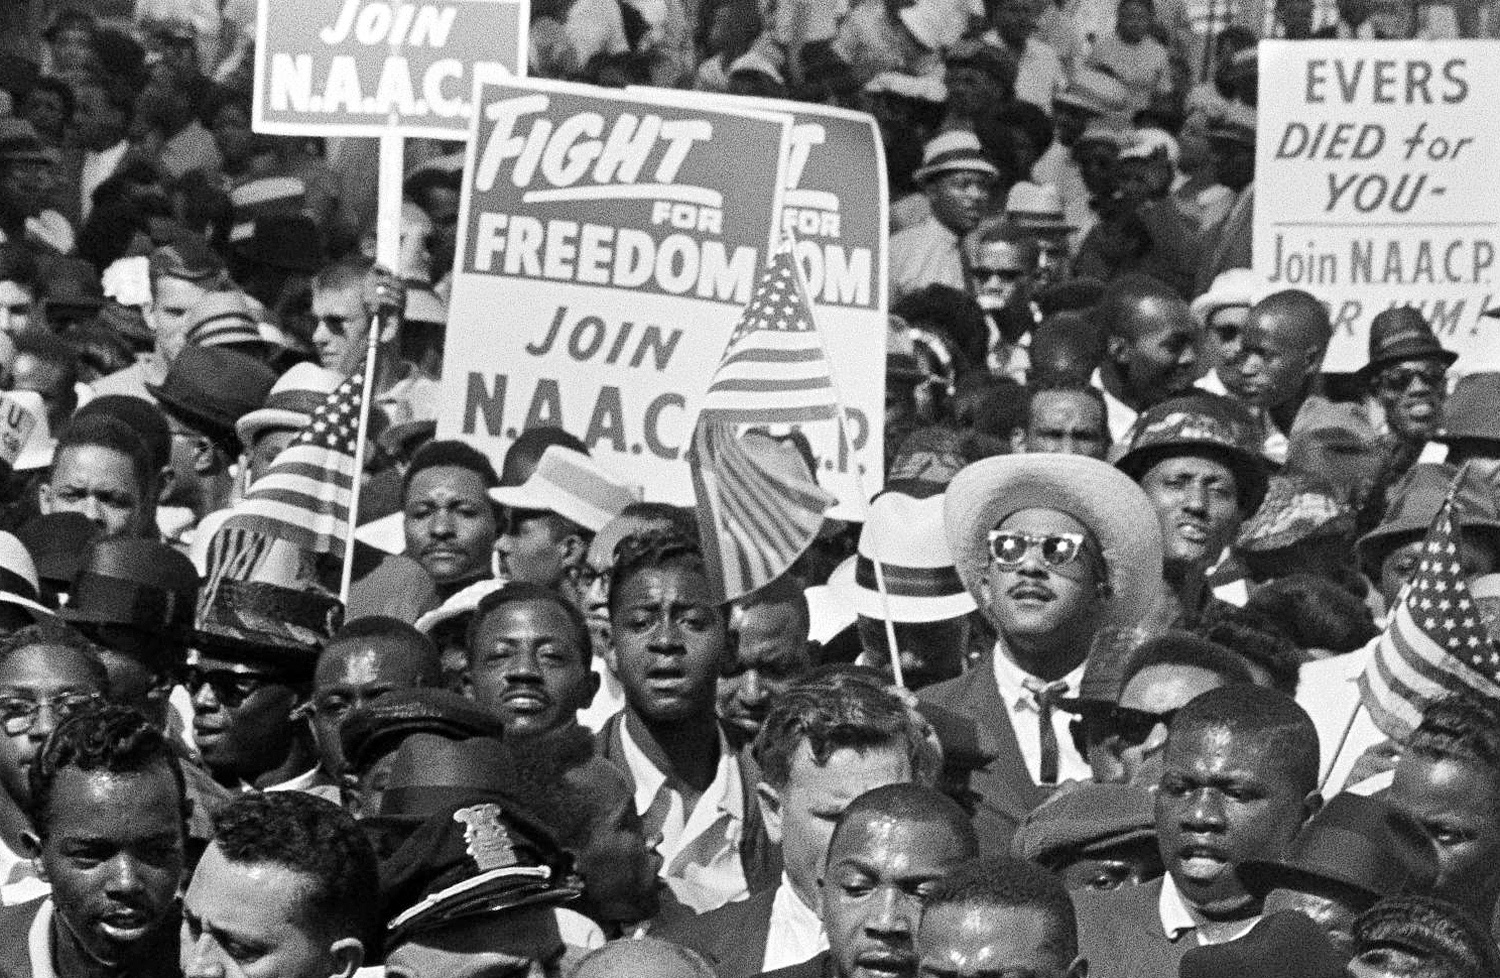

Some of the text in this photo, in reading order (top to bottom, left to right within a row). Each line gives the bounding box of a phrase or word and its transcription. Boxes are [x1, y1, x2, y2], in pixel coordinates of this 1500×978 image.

[319, 0, 457, 48] JOIN
[1305, 59, 1470, 104] EVERS
[475, 94, 713, 192] FIGHT
[1275, 121, 1474, 160] DIED for
[652, 201, 723, 235] FOR
[474, 212, 757, 304] FREEDOM
[1267, 234, 1338, 284] Join
[526, 306, 684, 371] JOIN
